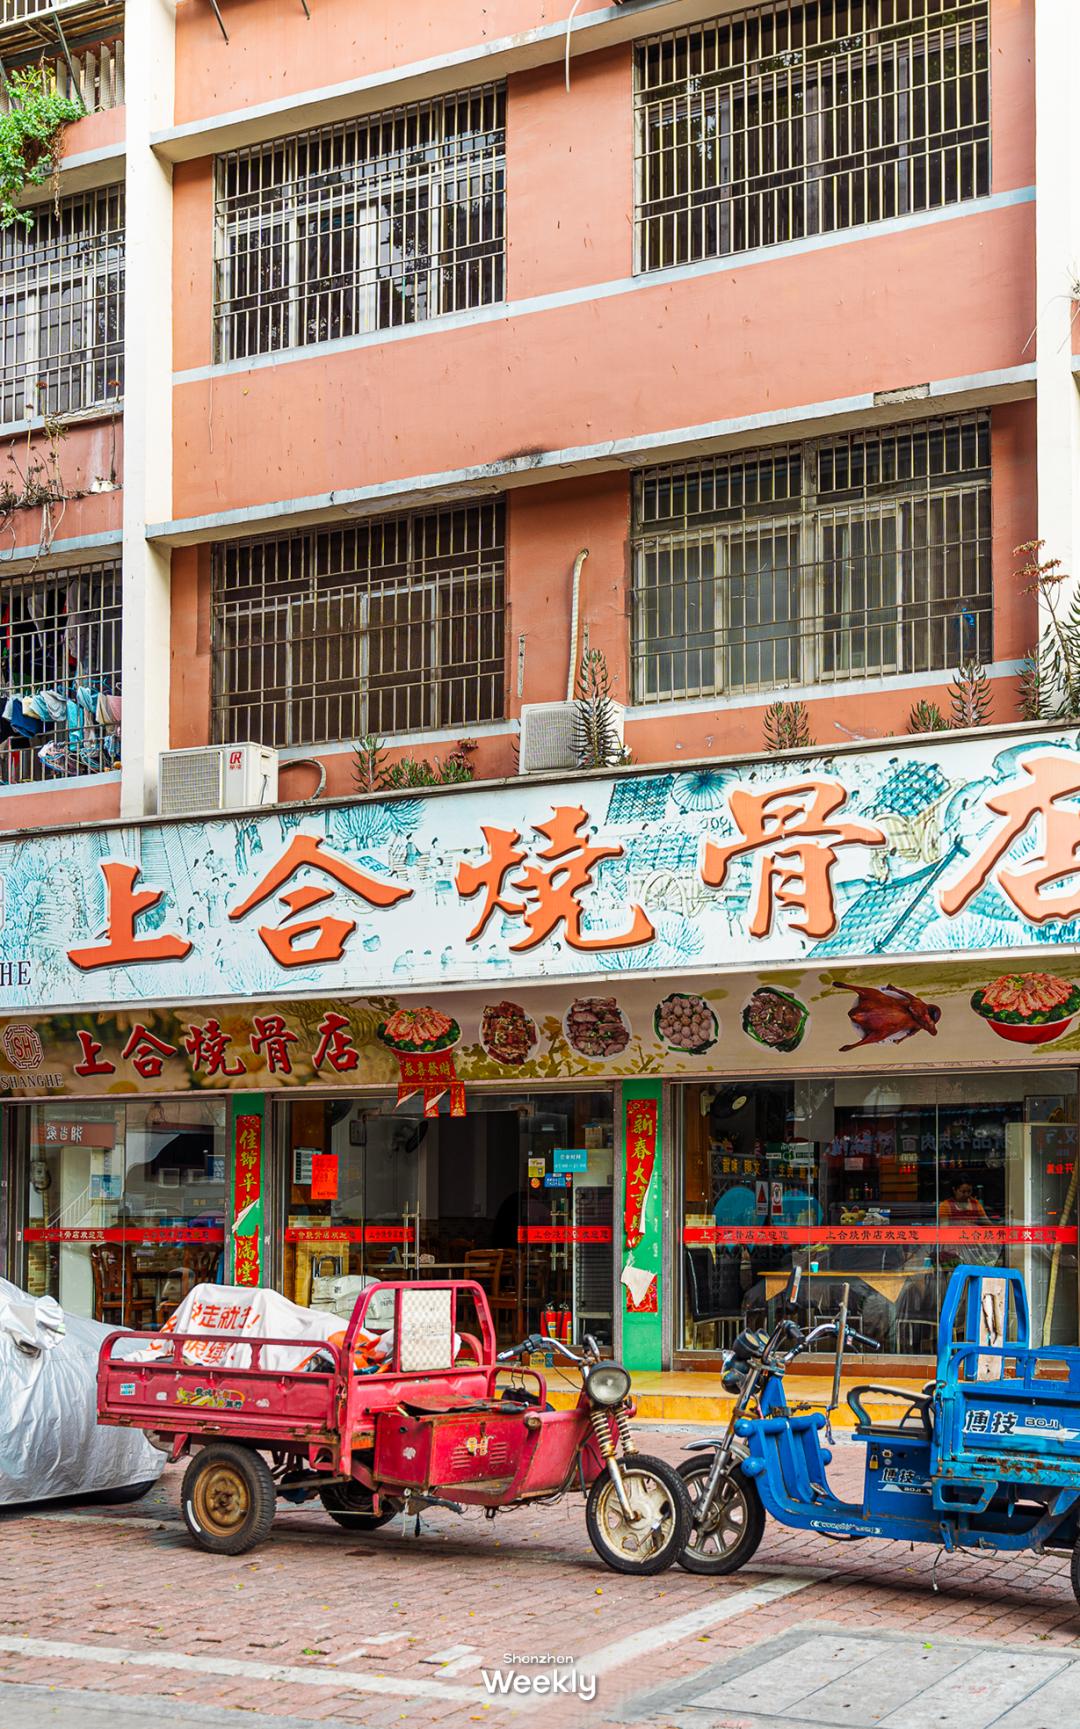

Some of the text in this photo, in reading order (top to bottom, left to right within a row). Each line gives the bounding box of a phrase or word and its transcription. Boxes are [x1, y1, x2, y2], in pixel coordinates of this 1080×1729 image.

[67, 755, 1080, 969] 上合燒骨店
[13, 1036, 33, 1060] SH
[73, 1011, 360, 1078] 上合燒骨店
[1, 1073, 63, 1090] SHANGHE
[825, 1227, 920, 1241] 上合烧骨店欢迎您
[965, 1409, 1018, 1436] 博技
